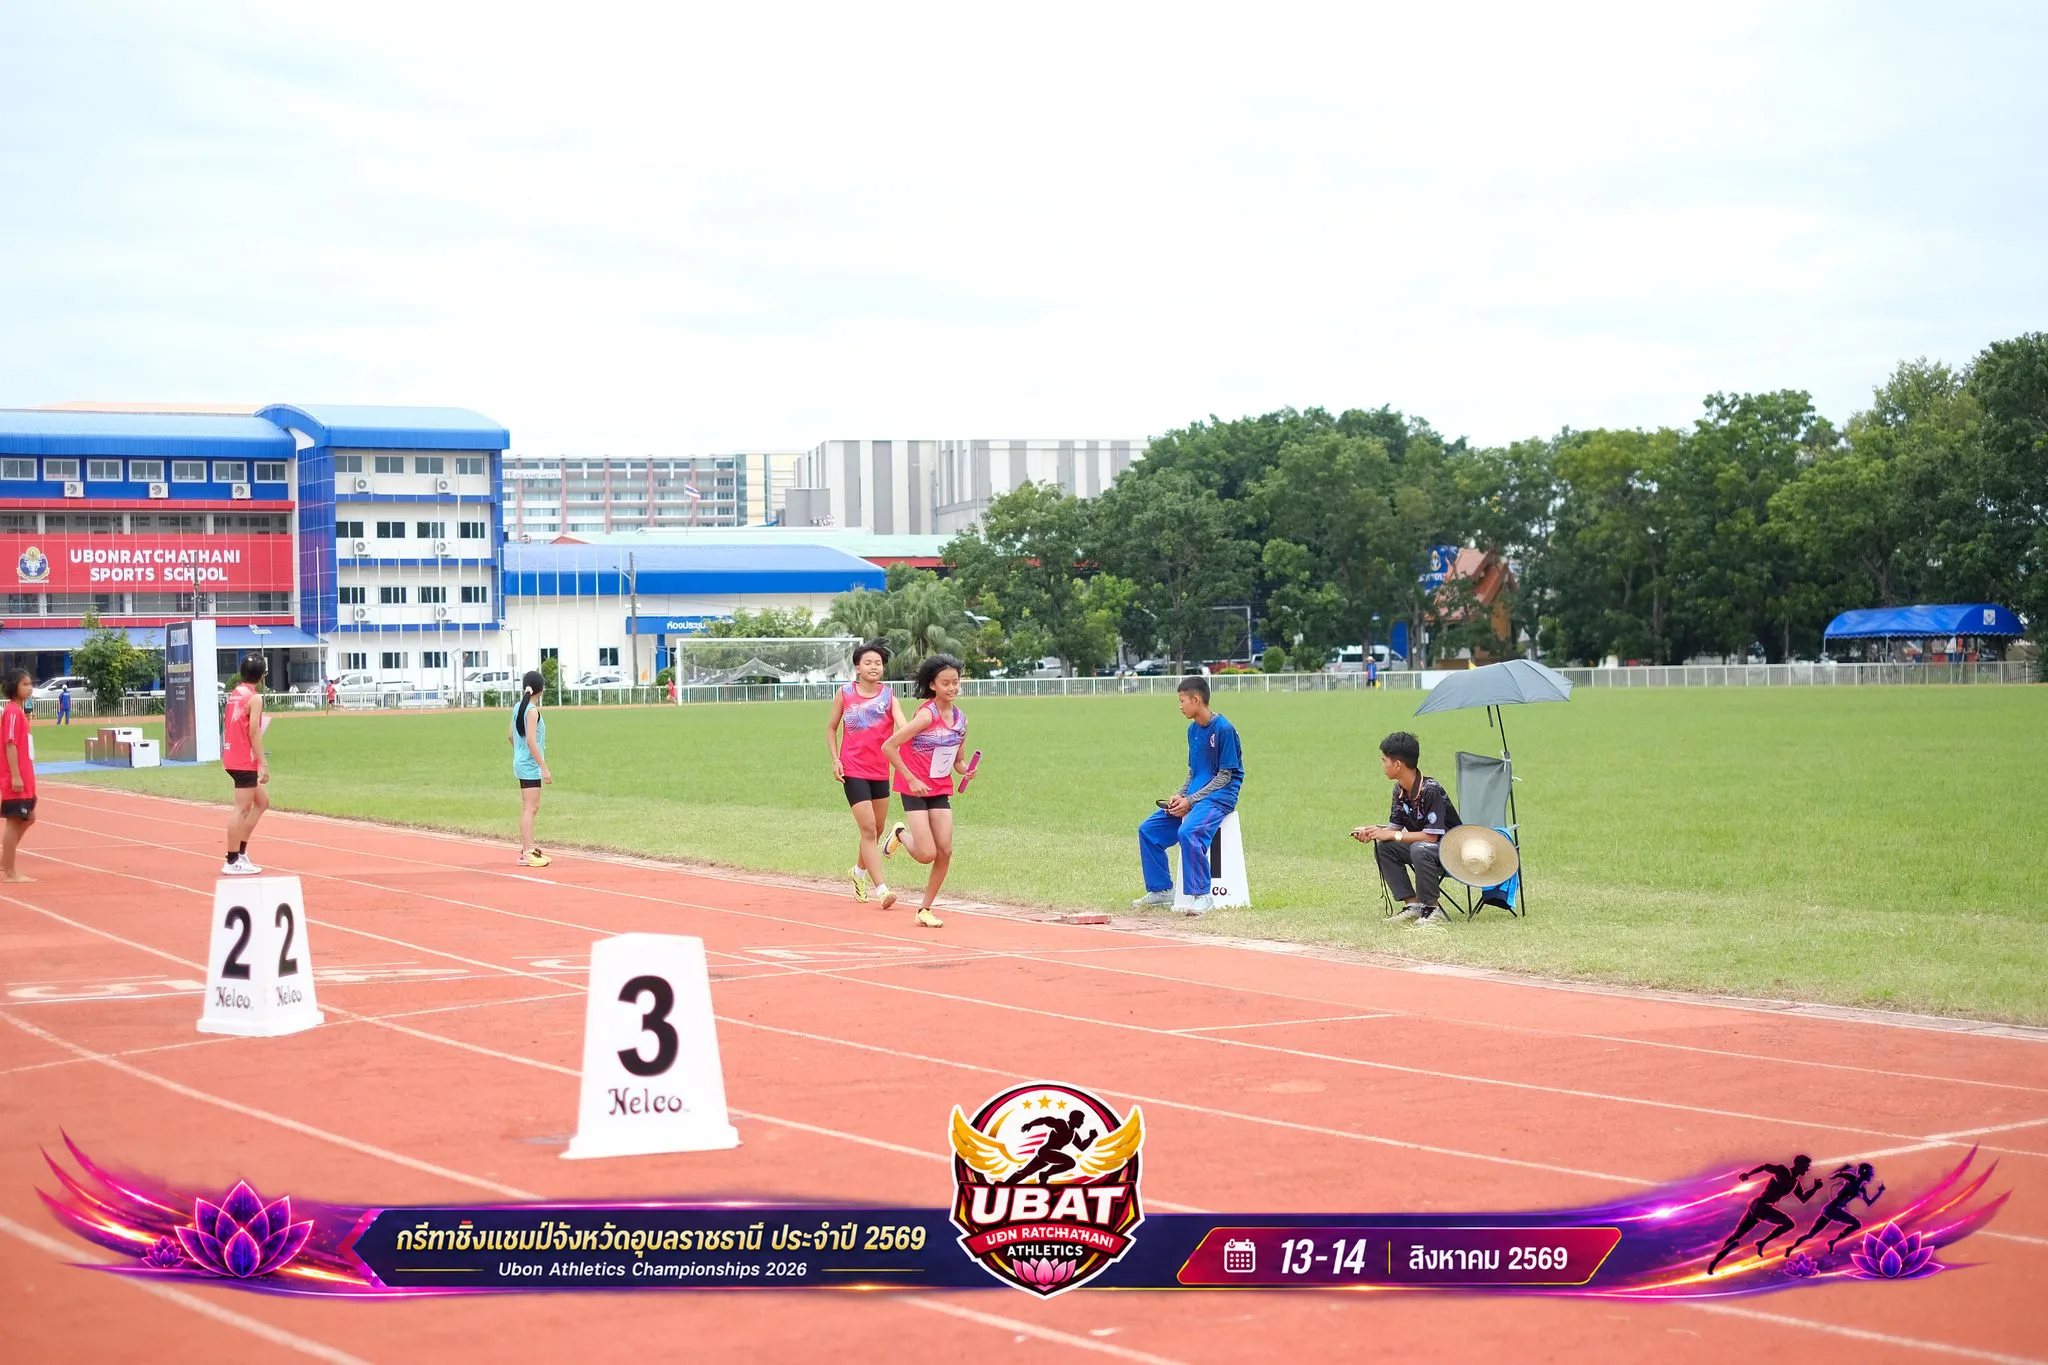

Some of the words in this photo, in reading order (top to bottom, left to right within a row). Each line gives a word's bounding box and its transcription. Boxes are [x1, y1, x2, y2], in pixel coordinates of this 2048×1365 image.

[70, 549, 240, 563] UBONRATCHATHANI
[90, 567, 155, 581] SPORTS
[164, 567, 228, 581] SCHOOL
[221, 906, 251, 980] 2
[275, 902, 299, 977] 2
[215, 986, 252, 1010] Nelco
[276, 985, 302, 1007] Nelco
[617, 974, 679, 1078] 3
[608, 1087, 684, 1116] Nelco
